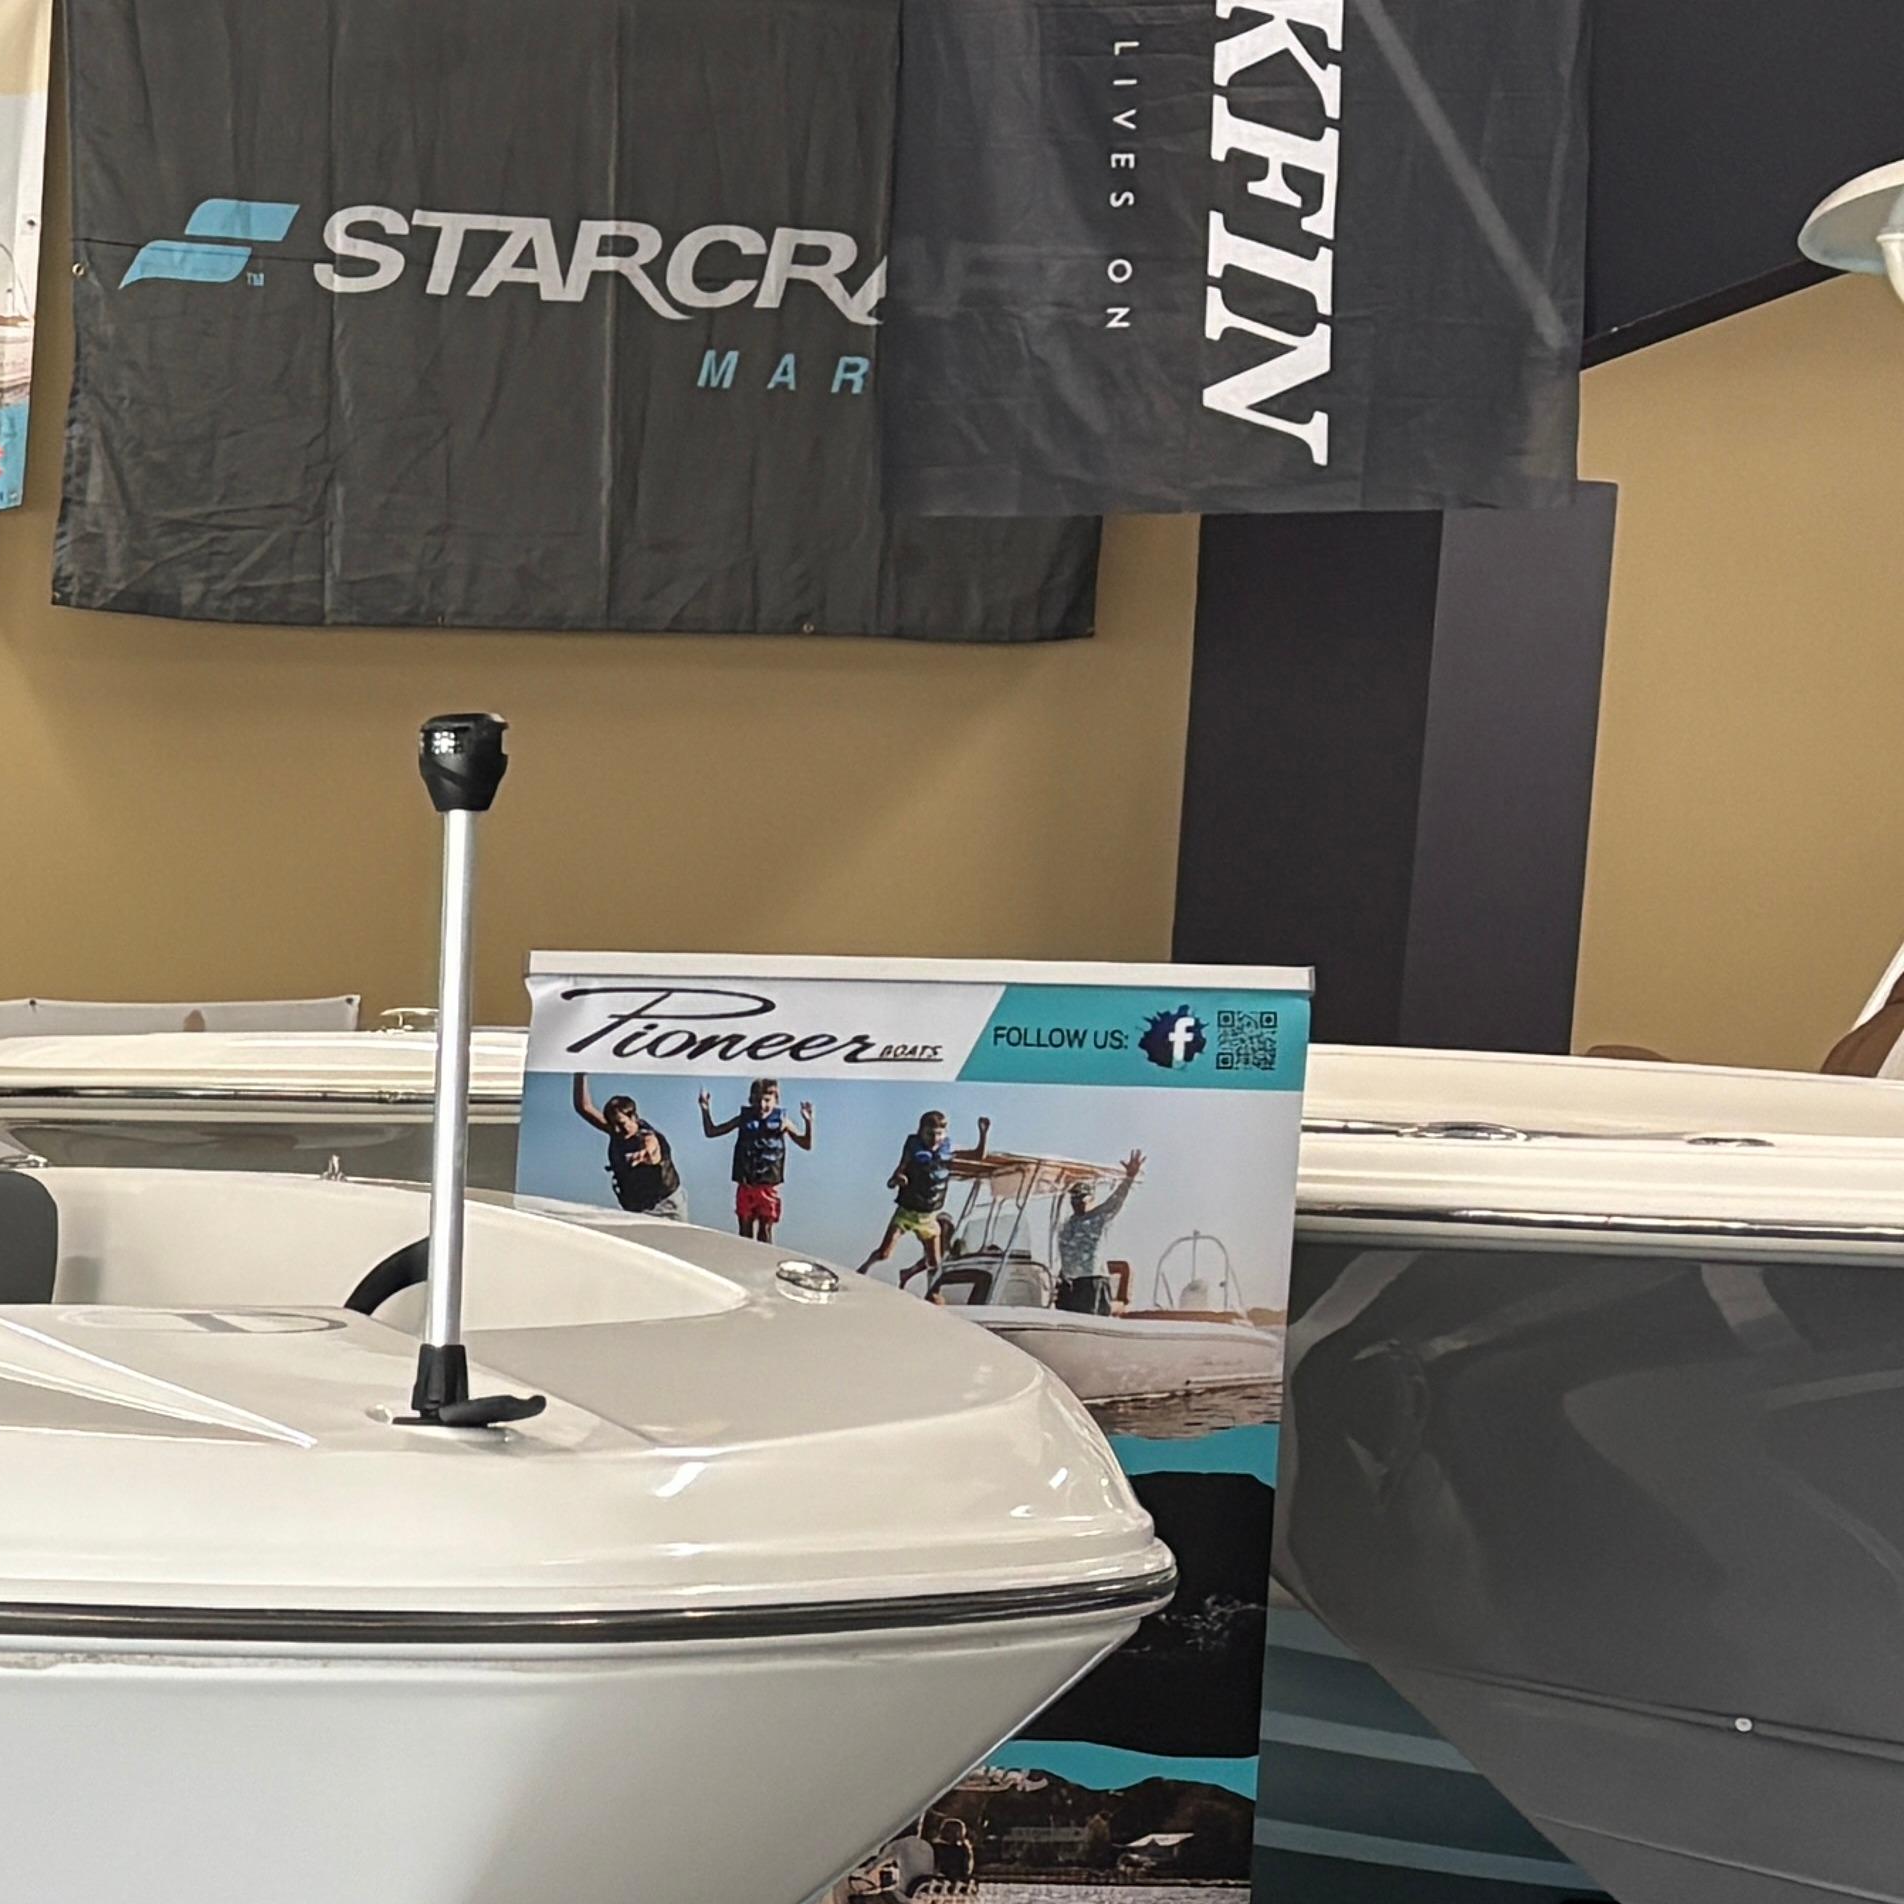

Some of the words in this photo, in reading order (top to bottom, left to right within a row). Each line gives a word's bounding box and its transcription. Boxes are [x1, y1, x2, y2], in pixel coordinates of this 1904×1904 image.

[1109, 41, 1140, 208] LIVES
[1202, 0, 1344, 467] KFIN
[1106, 259, 1133, 328] ON
[697, 350, 871, 394] MAR
[561, 987, 883, 1063] Pioneer
[992, 1026, 1088, 1049] FOLLOW
[1093, 1029, 1130, 1050] US:
